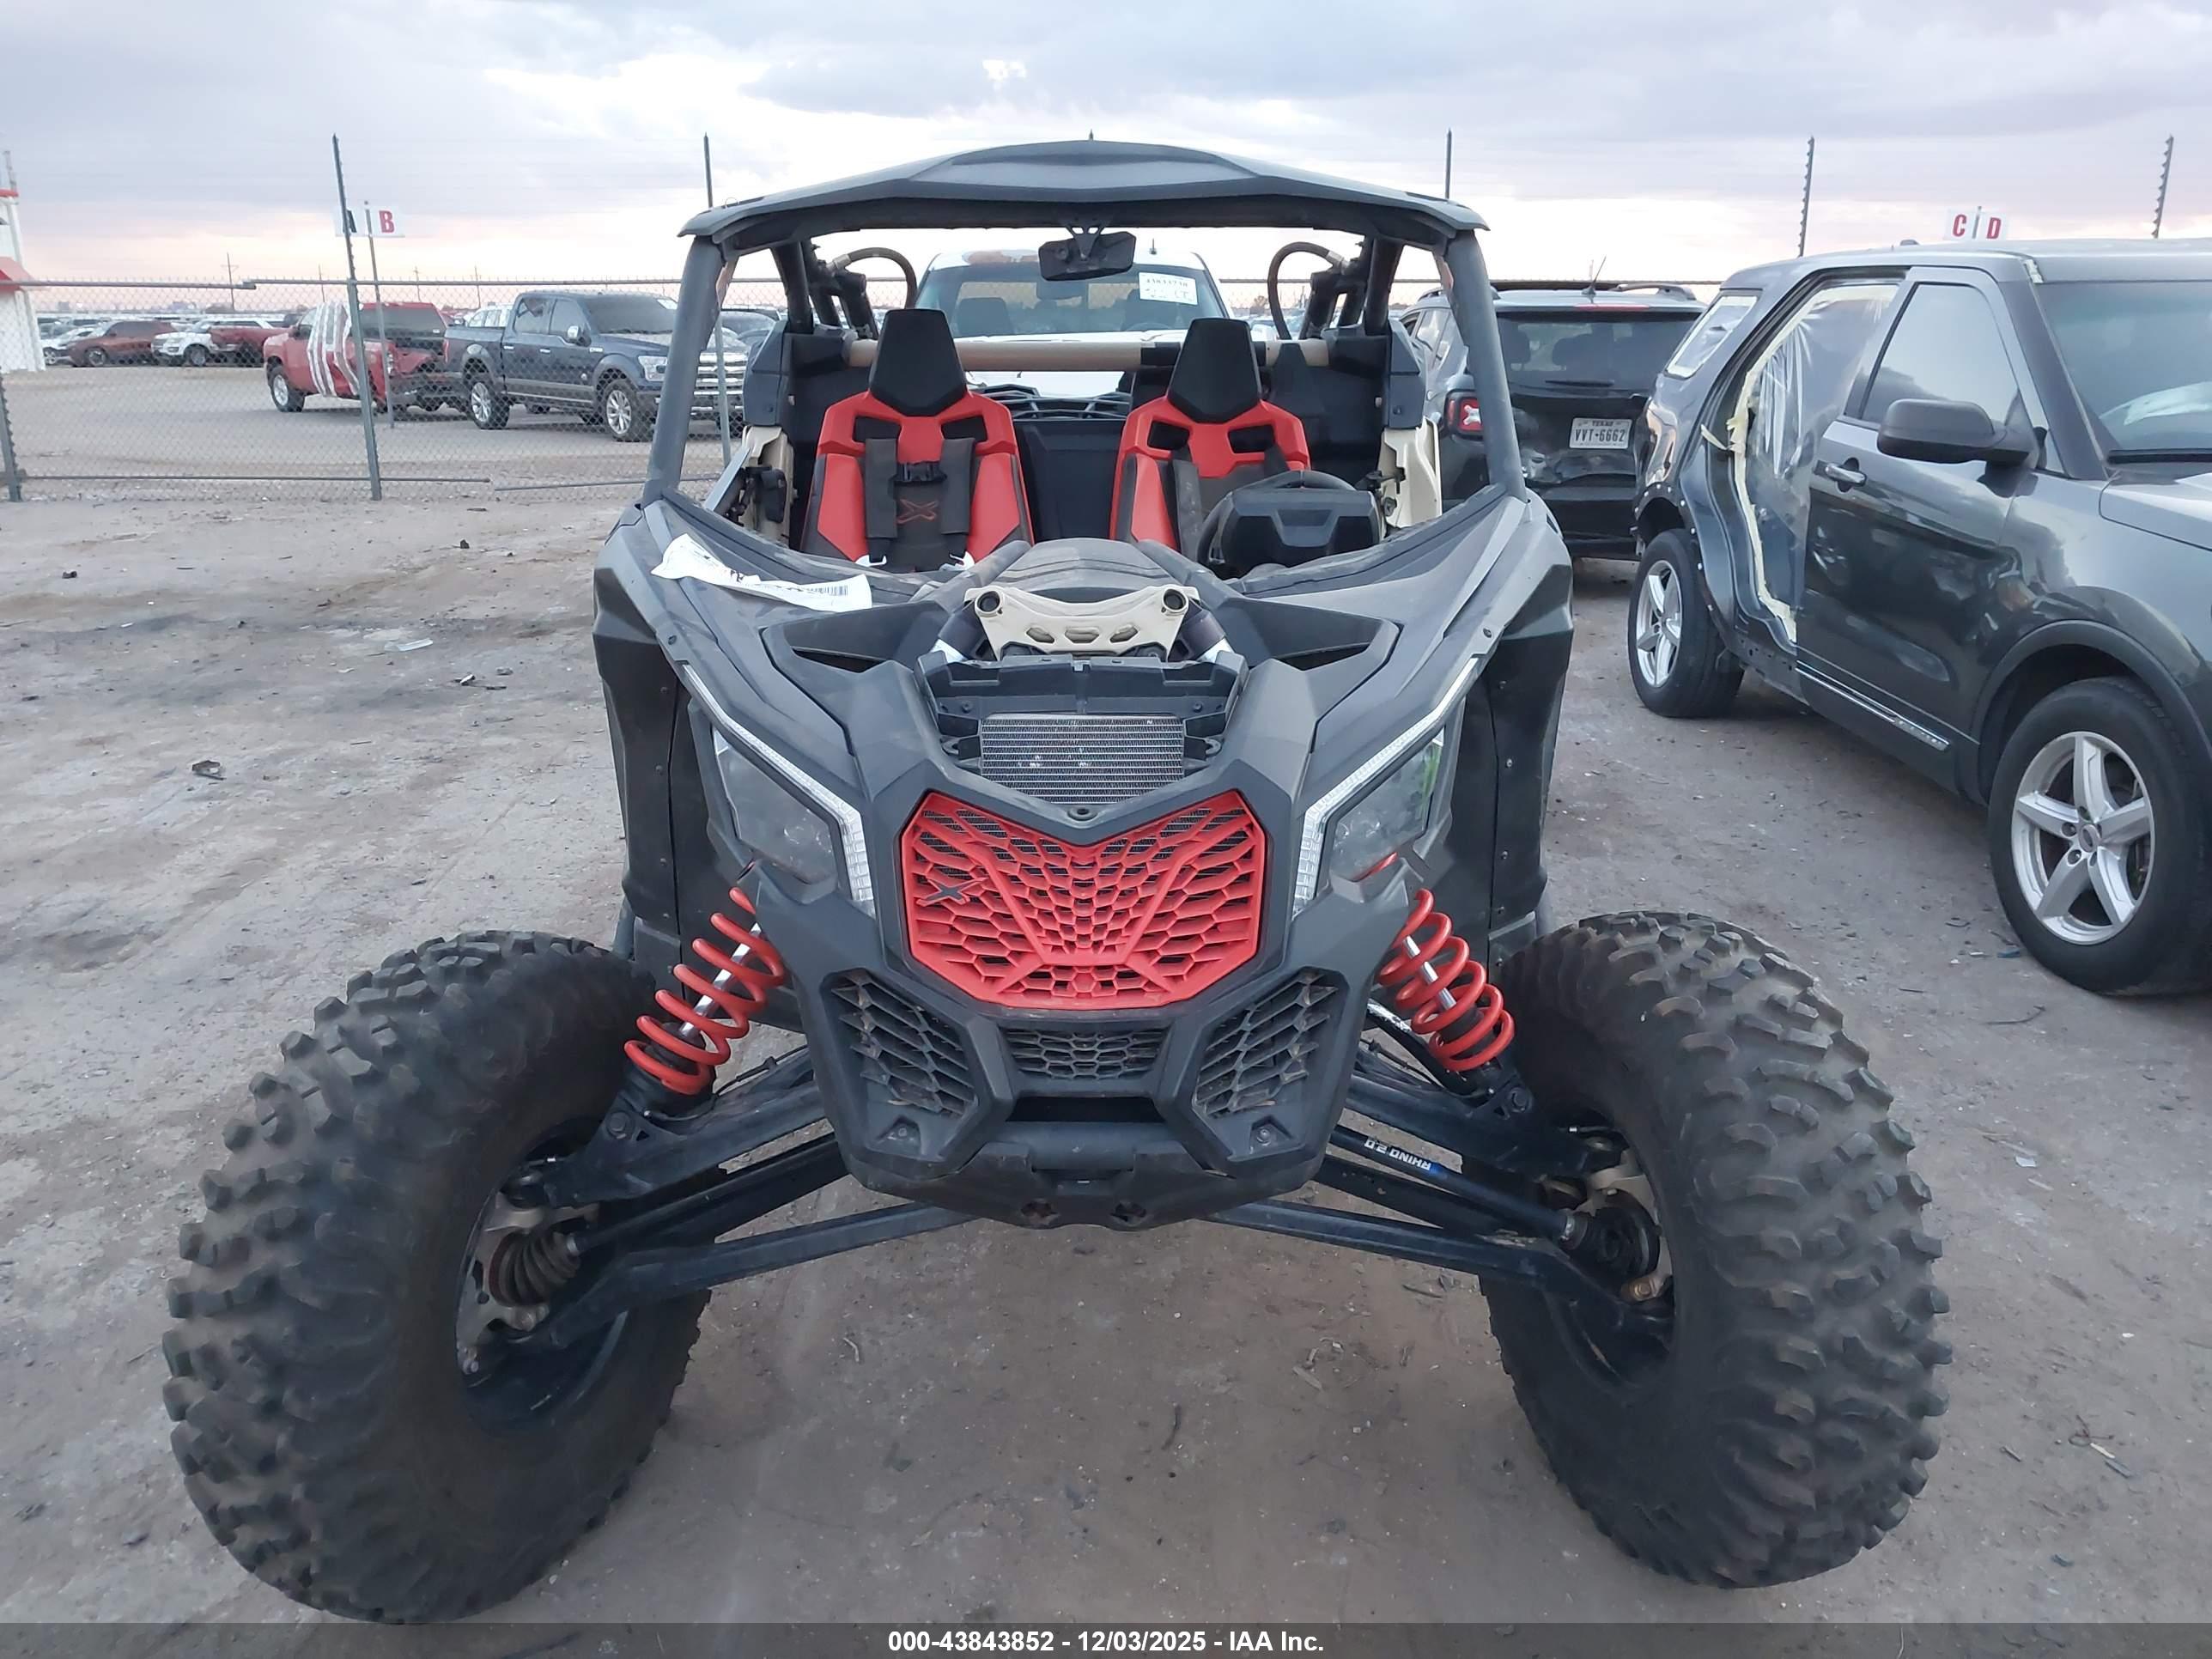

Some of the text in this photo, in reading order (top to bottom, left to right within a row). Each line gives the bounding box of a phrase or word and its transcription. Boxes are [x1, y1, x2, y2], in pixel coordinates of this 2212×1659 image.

[379, 210, 395, 233] B
[1953, 214, 1967, 237] C
[1986, 217, 2002, 240] D
[1389, 1147, 1431, 1171] RHINO
